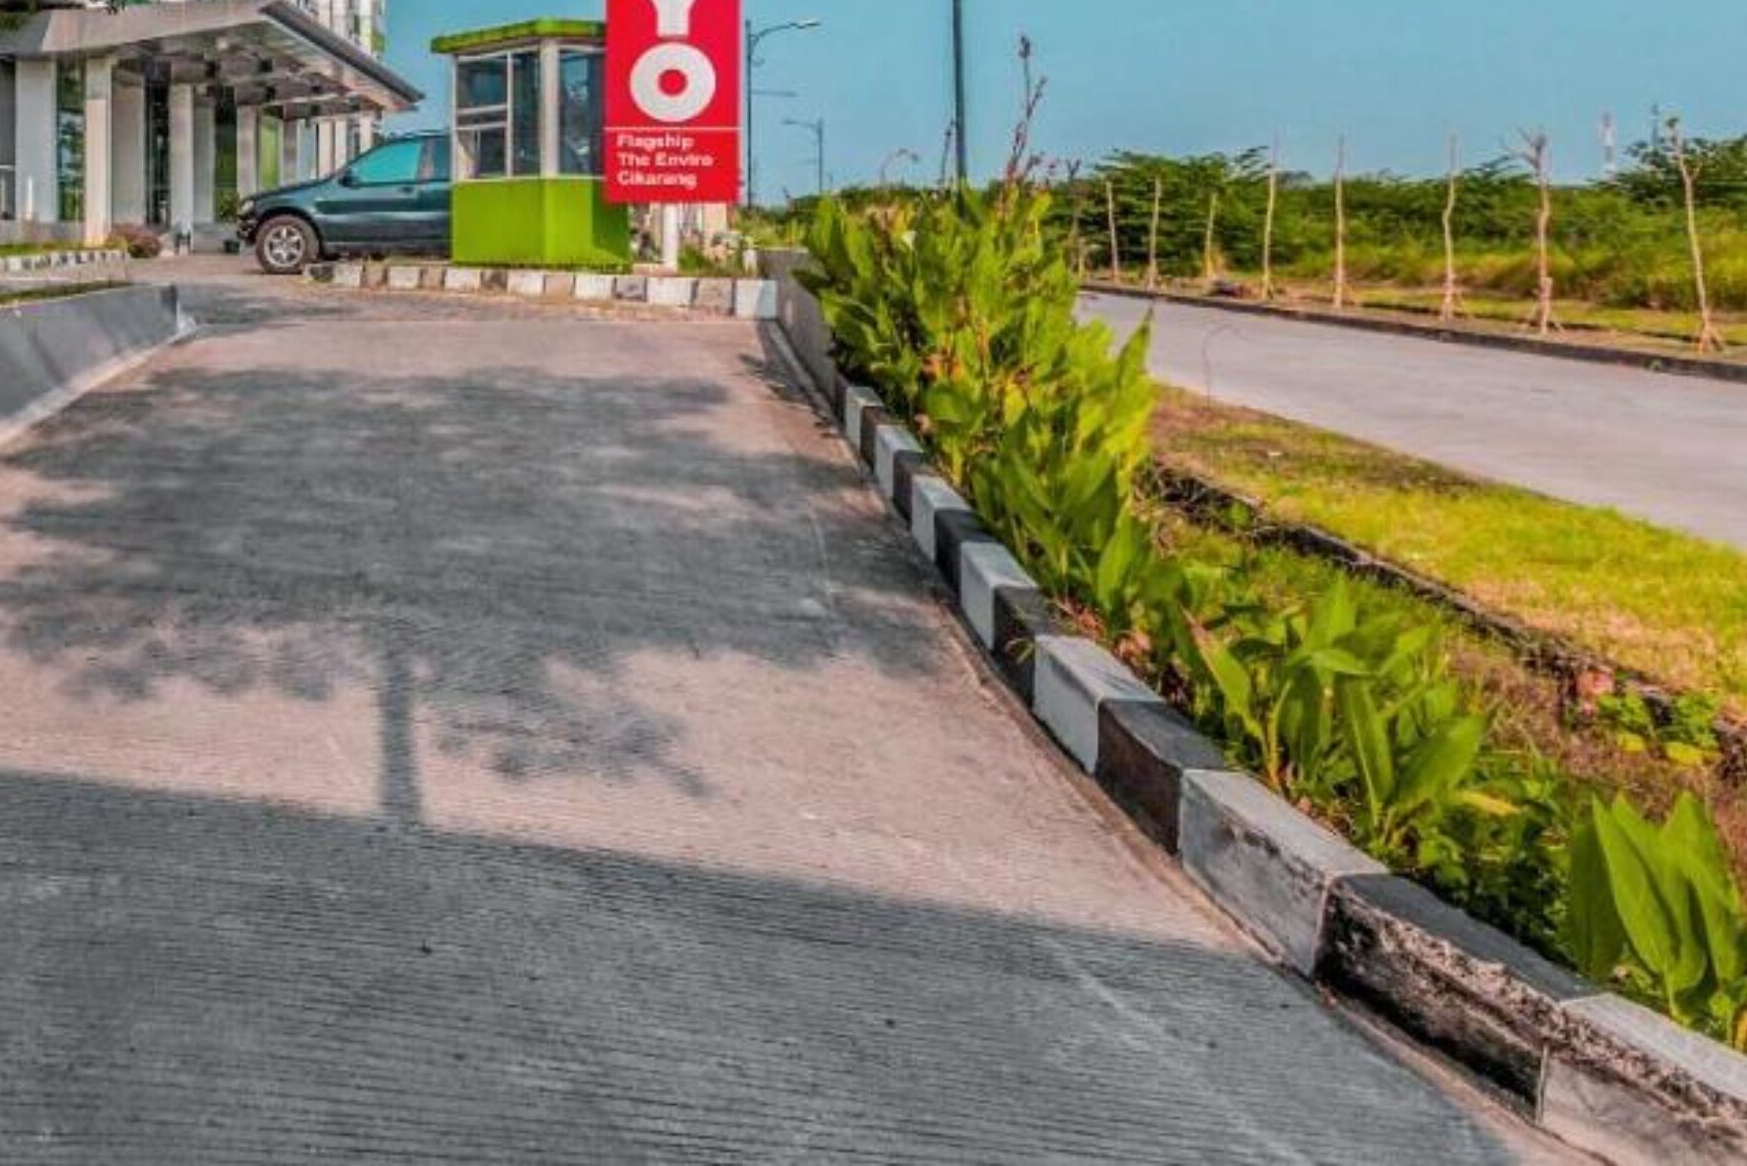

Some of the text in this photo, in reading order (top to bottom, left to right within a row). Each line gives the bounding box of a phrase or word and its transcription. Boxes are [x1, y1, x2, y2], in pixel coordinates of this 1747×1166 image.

[617, 133, 694, 151] Flagship
[617, 152, 713, 166] The Enviro
[617, 170, 697, 190] Cikarang
